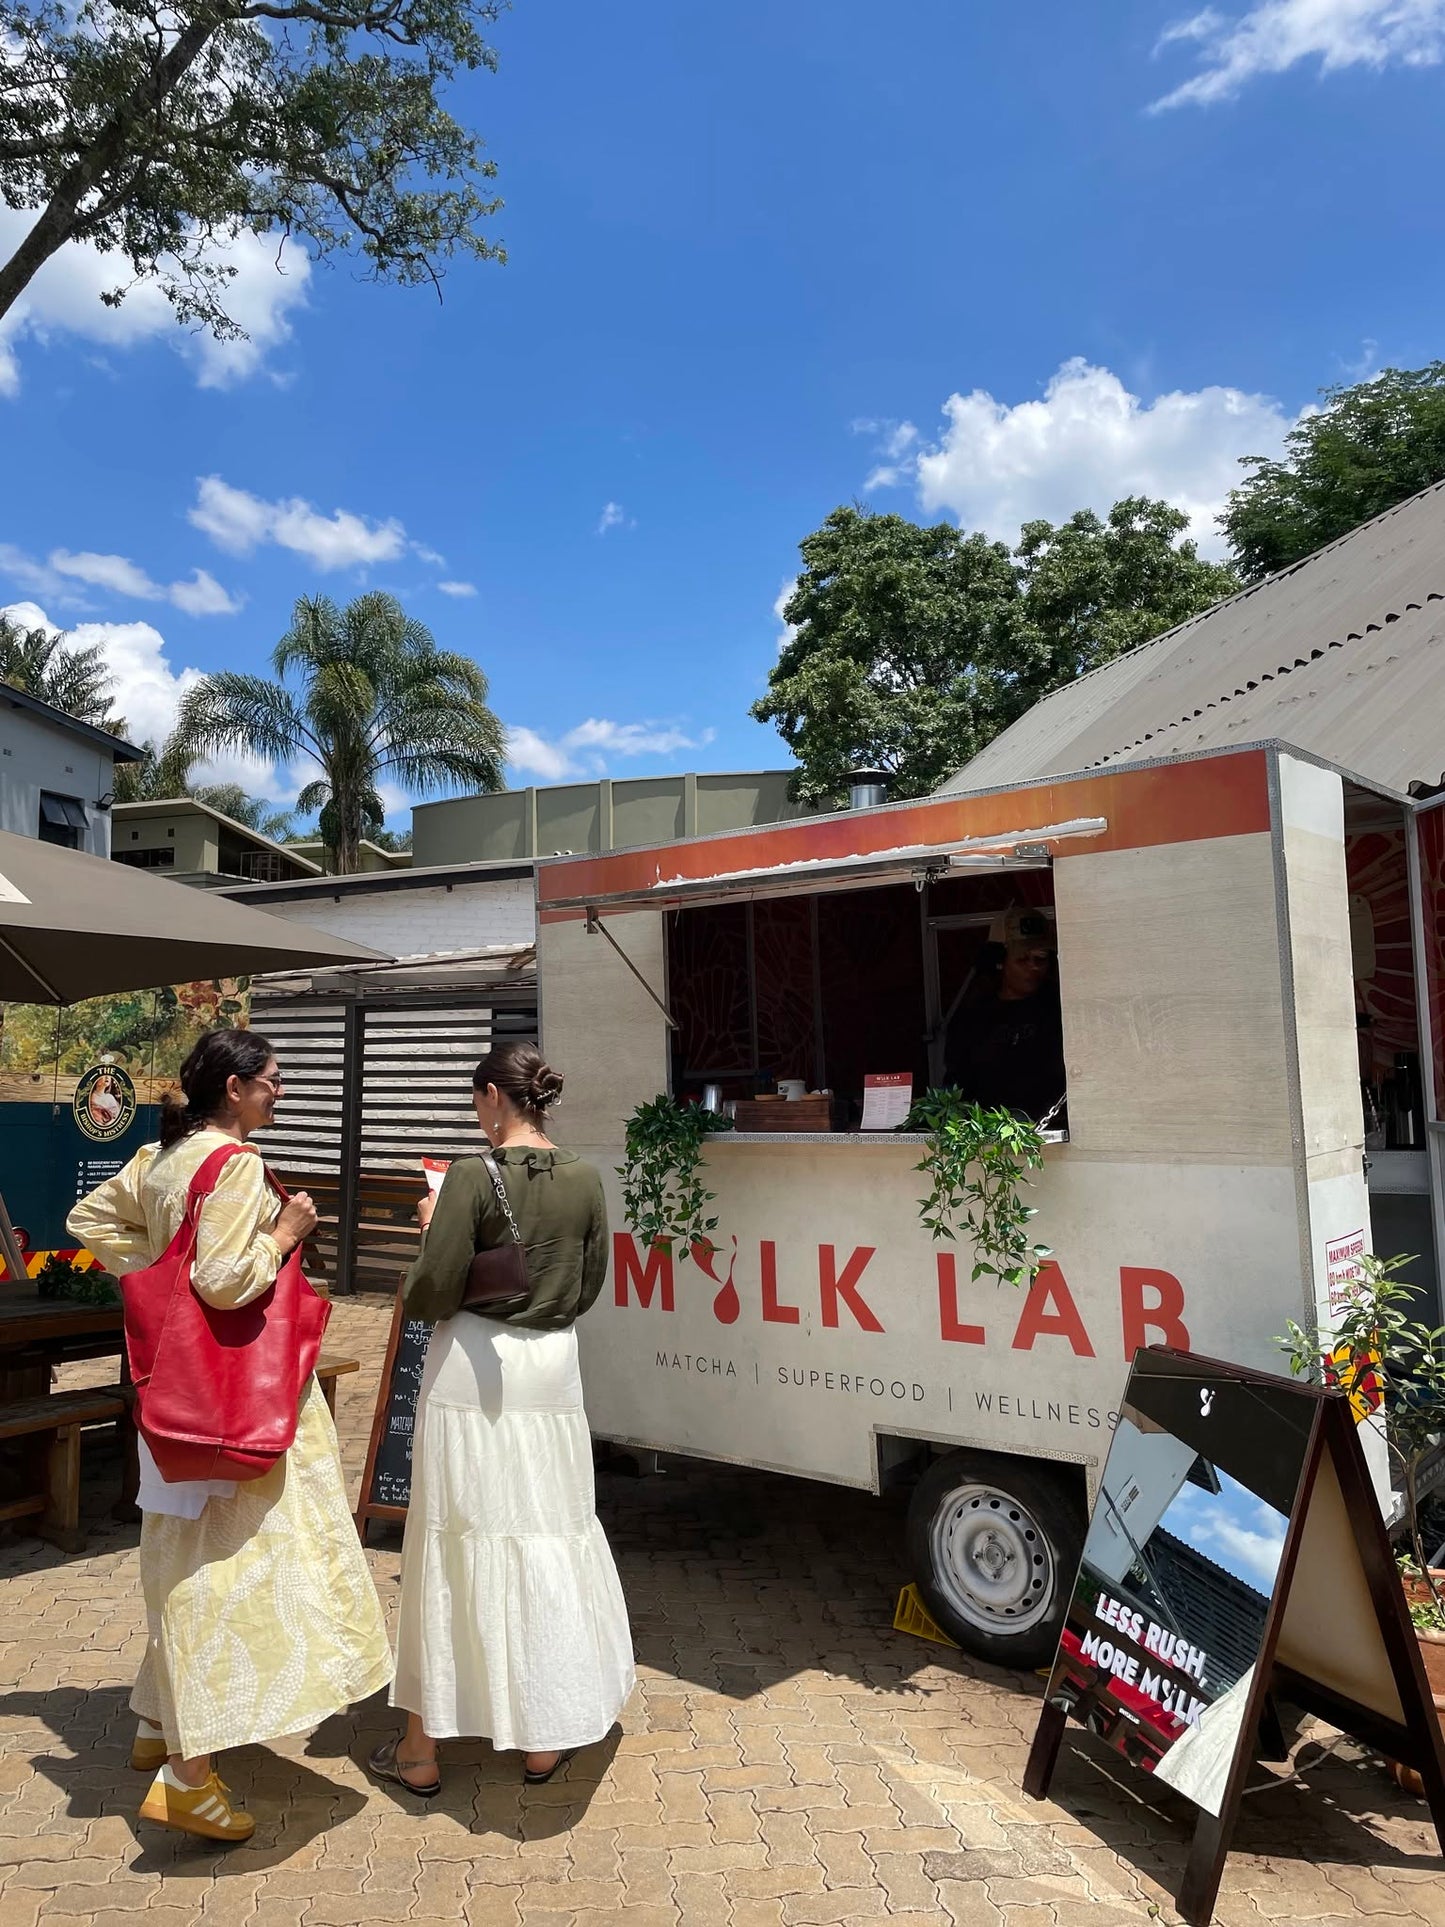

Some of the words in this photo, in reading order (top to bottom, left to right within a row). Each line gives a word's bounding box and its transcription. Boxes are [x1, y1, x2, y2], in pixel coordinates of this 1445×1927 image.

[97, 1067, 116, 1075] THE
[80, 1113, 103, 1137] BISHOP'S
[103, 1112, 130, 1137] MISTRESS
[936, 1252, 1190, 1362] LAB
[655, 1351, 737, 1377] MATCHA
[778, 1366, 925, 1402] SUPERFOOD
[975, 1391, 1119, 1431] WELLNESS
[1080, 1629, 1139, 1686] MORE
[1095, 1592, 1144, 1641] LESS
[1144, 1621, 1208, 1688] RUSH,
